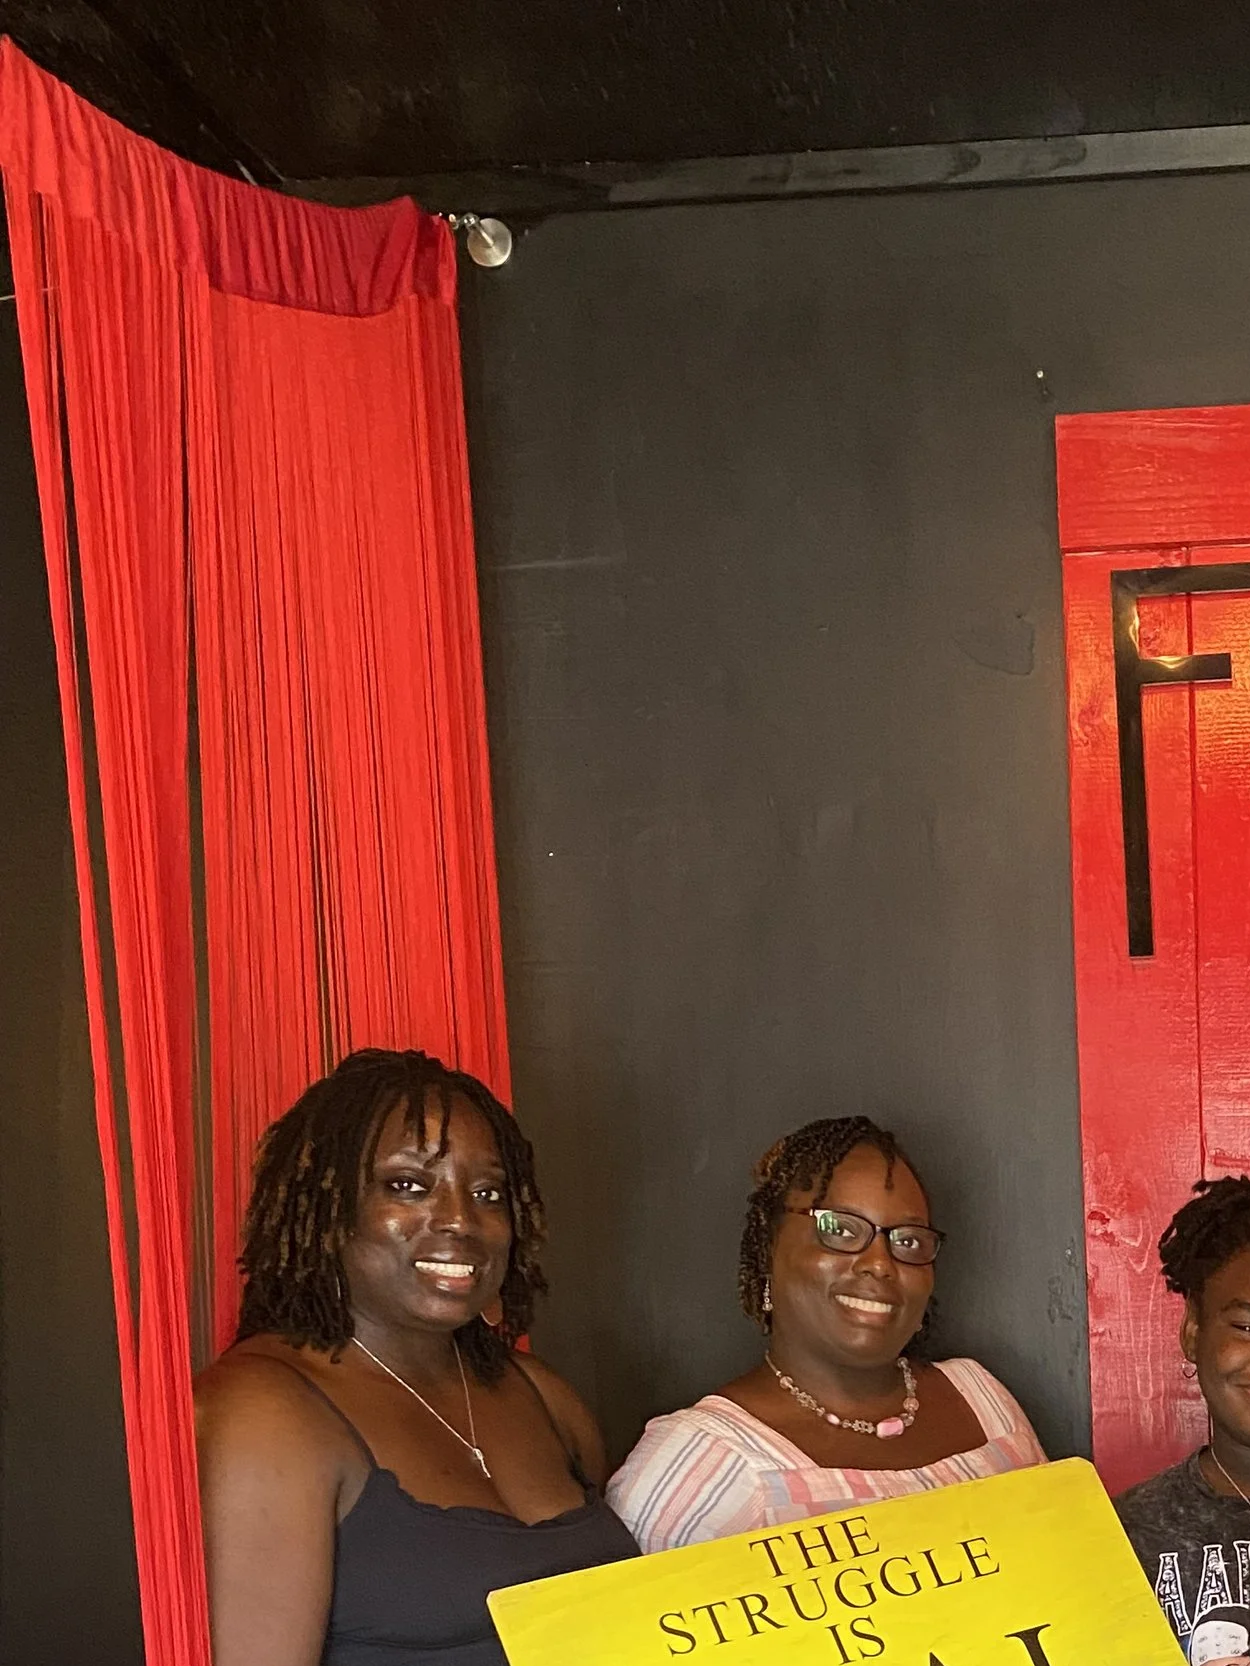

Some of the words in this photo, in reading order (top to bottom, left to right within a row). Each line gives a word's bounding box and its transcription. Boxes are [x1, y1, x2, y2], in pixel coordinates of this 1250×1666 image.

[749, 1516, 881, 1579] THE
[657, 1537, 1001, 1657] STRUGGLE
[826, 1616, 886, 1666] IS
